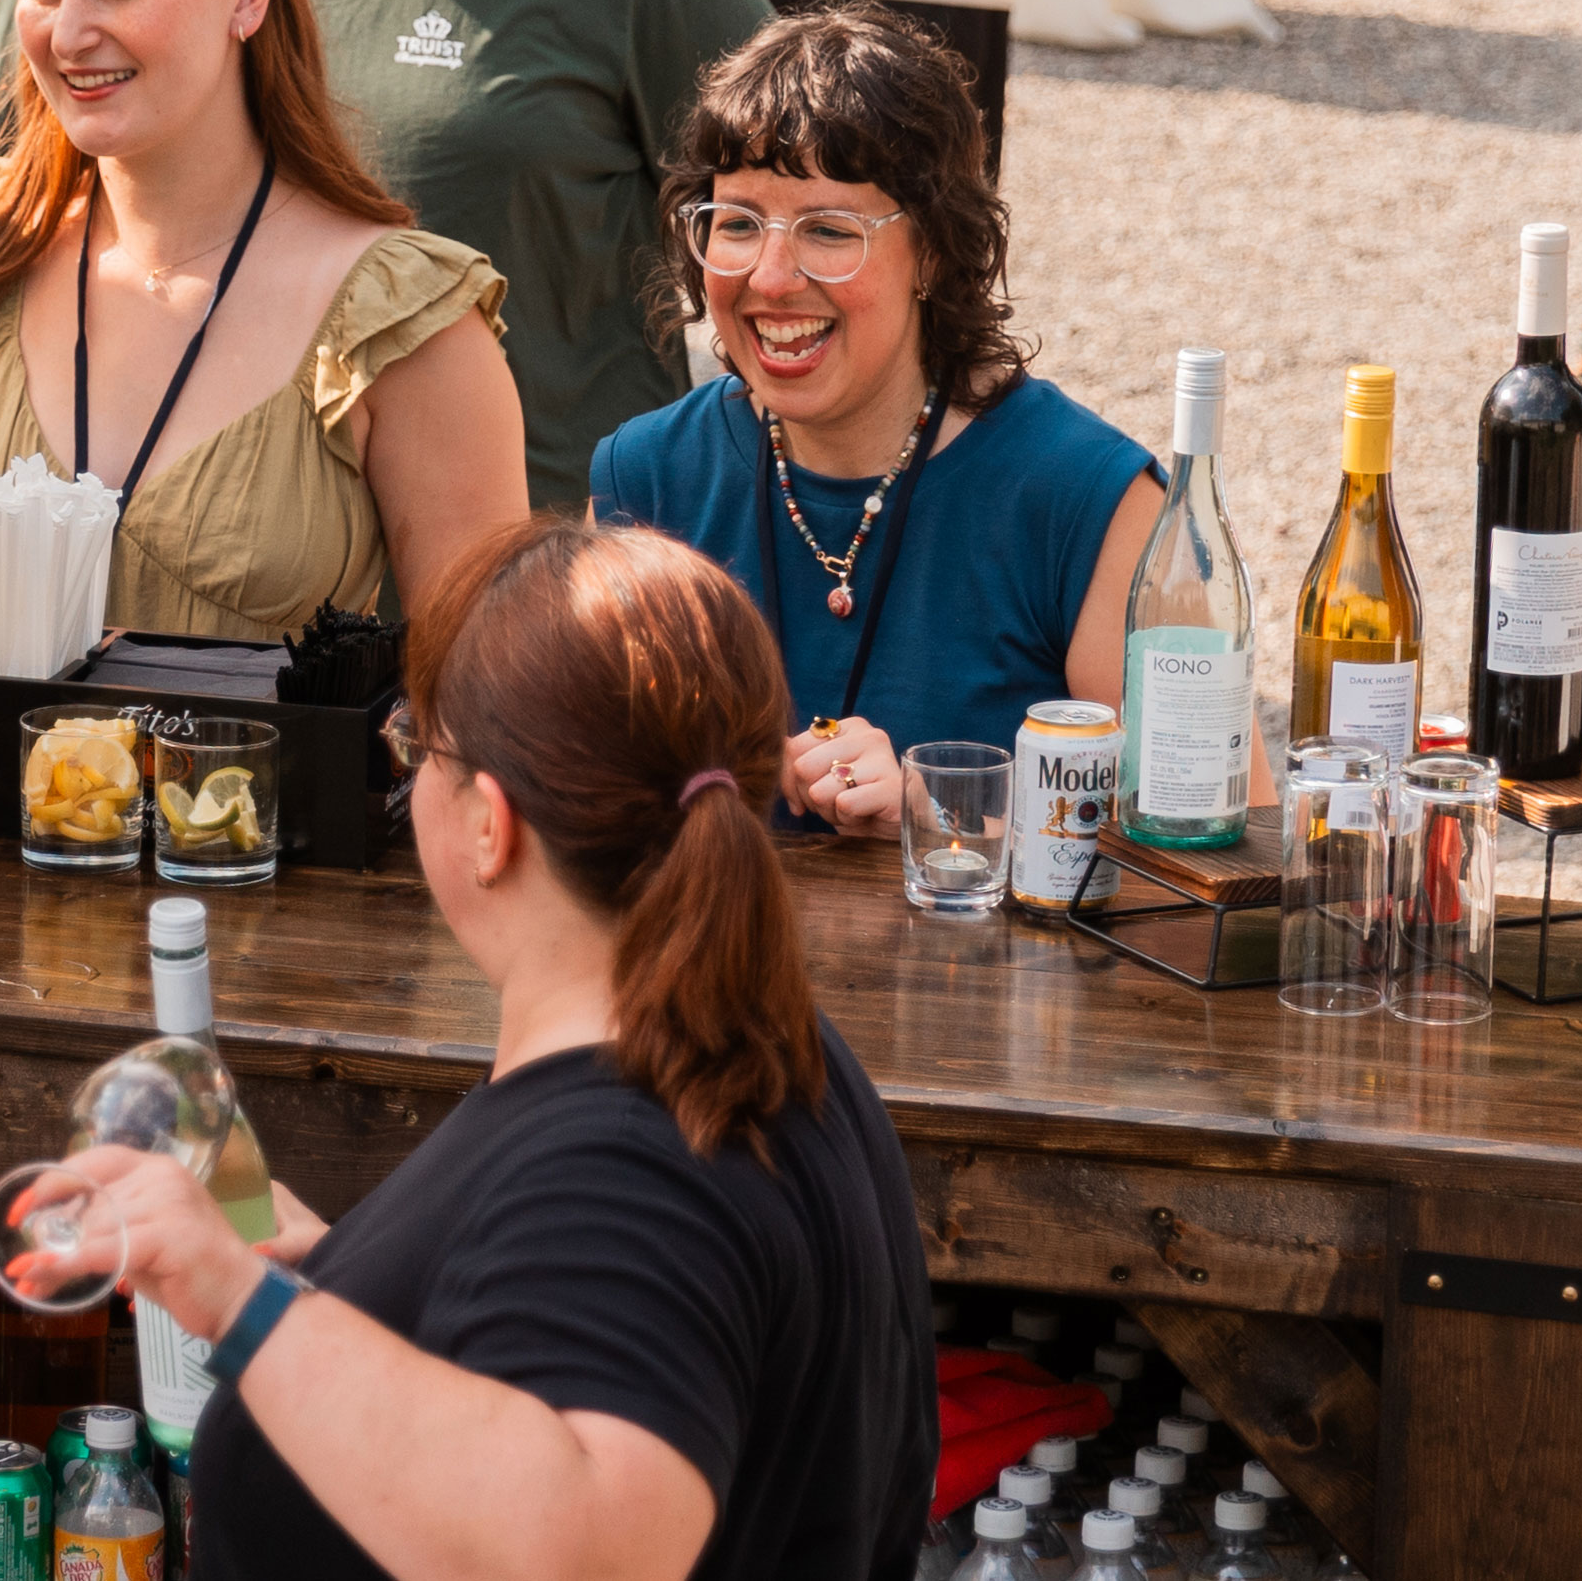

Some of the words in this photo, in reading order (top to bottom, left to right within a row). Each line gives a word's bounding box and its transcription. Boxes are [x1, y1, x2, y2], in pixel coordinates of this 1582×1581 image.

[396, 35, 466, 57] TRUIST
[1153, 656, 1212, 675] KONO
[1349, 676, 1373, 685] DARK
[1375, 675, 1409, 685] HARVEST
[59, 1560, 104, 1576] CANADA
